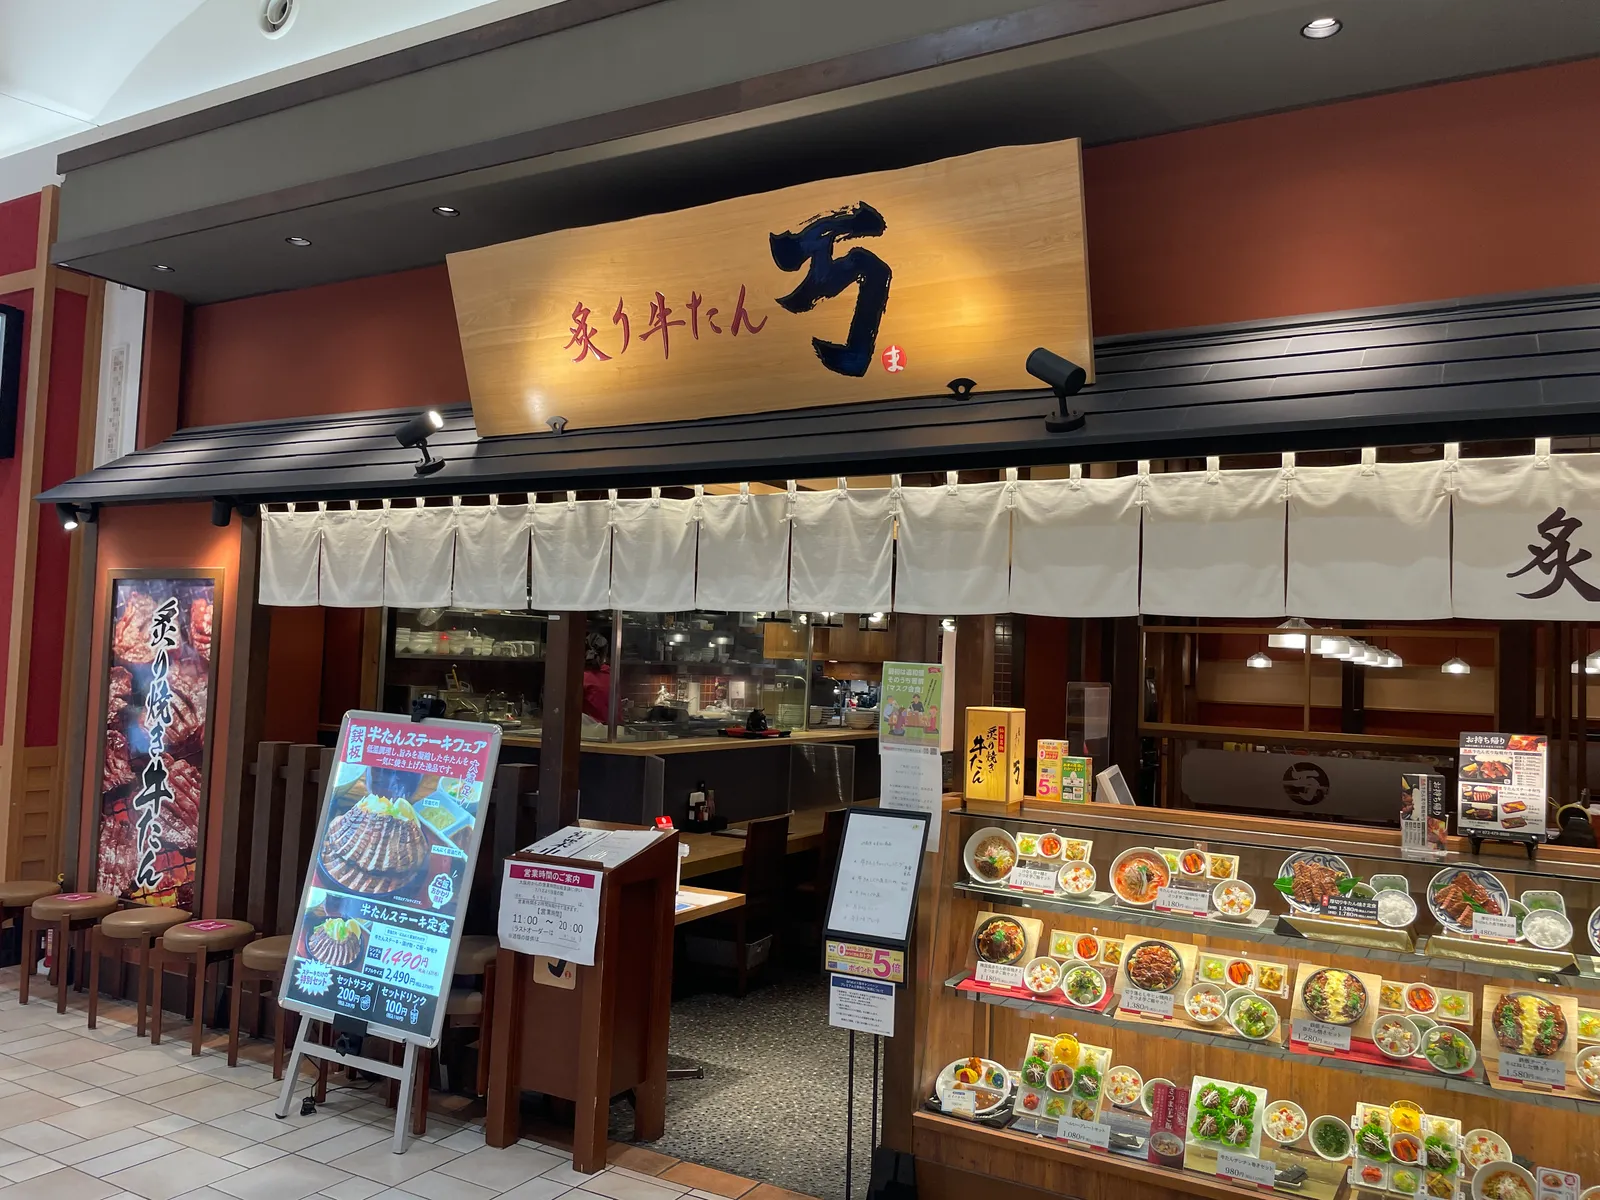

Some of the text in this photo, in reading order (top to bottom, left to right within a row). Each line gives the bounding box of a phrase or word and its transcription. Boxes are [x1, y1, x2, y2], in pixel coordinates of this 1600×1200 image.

[563, 284, 768, 363] 炙り牛たん
[883, 345, 907, 374] ま
[1506, 506, 1600, 602] 炙
[134, 597, 179, 888] 炙り焼き牛たん
[367, 726, 488, 754] 牛たんステーキフェア
[1465, 735, 1505, 745] お持ち帰り
[986, 726, 997, 773] 炙り焼き
[969, 735, 988, 784] 牛たん
[1038, 779, 1050, 795] 5
[523, 868, 580, 884] 営業時間のご案内
[360, 903, 450, 935] 牛たんステーキ定食
[513, 913, 538, 926] 11:00
[382, 948, 429, 970] 1,490円
[873, 950, 901, 977] 5 倍
[385, 967, 416, 986] 2,490円
[848, 964, 872, 974] ポイント
[300, 976, 328, 986] 特別セット
[336, 974, 374, 992] セットサラダ
[336, 987, 360, 1003] 200円
[381, 986, 427, 1006] セットドリンク
[385, 999, 408, 1016] 100円
[1506, 1069, 1534, 1079] 1,580円
[1063, 1130, 1085, 1140] 1,080円
[1225, 1166, 1245, 1177] 980円
